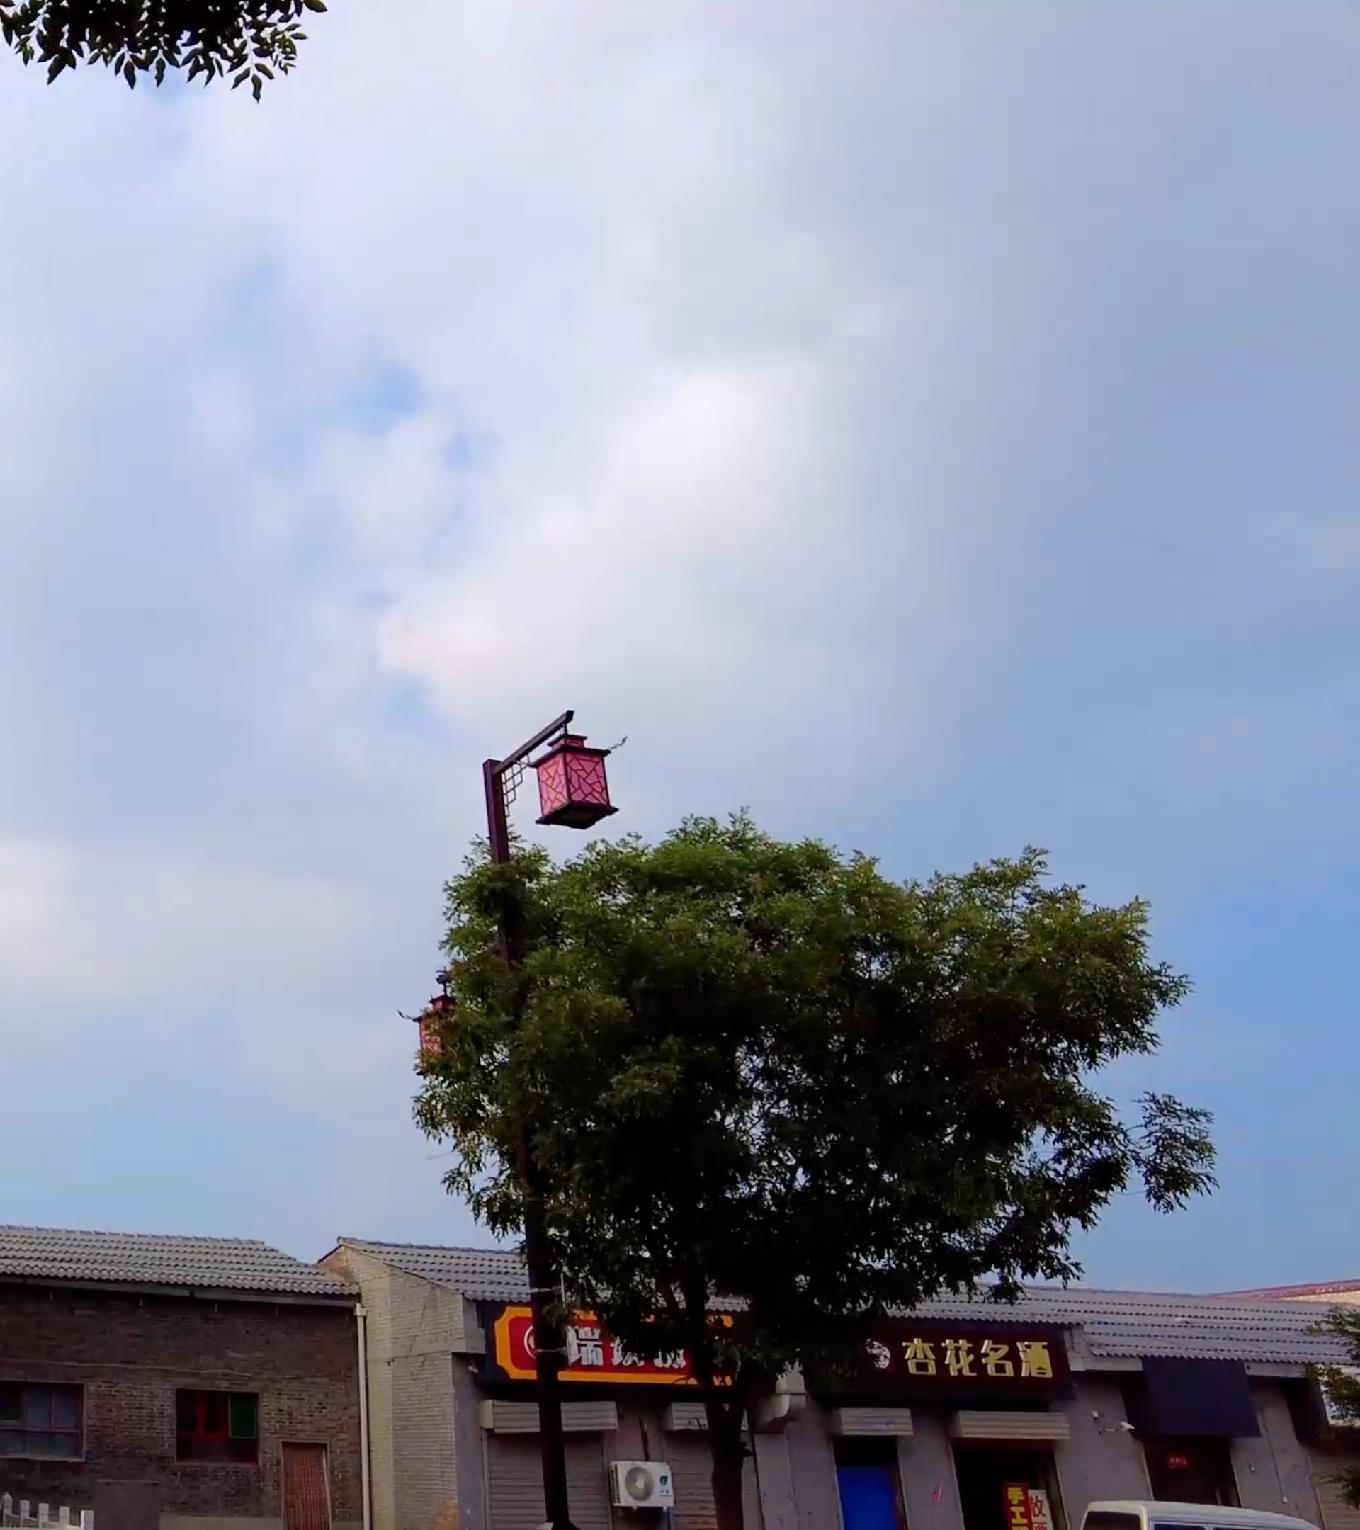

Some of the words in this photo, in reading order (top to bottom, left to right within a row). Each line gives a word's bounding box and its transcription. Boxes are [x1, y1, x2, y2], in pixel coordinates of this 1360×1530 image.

[902, 1338, 1053, 1378] 杏花名酒
[1007, 1487, 1029, 1530] 手工
